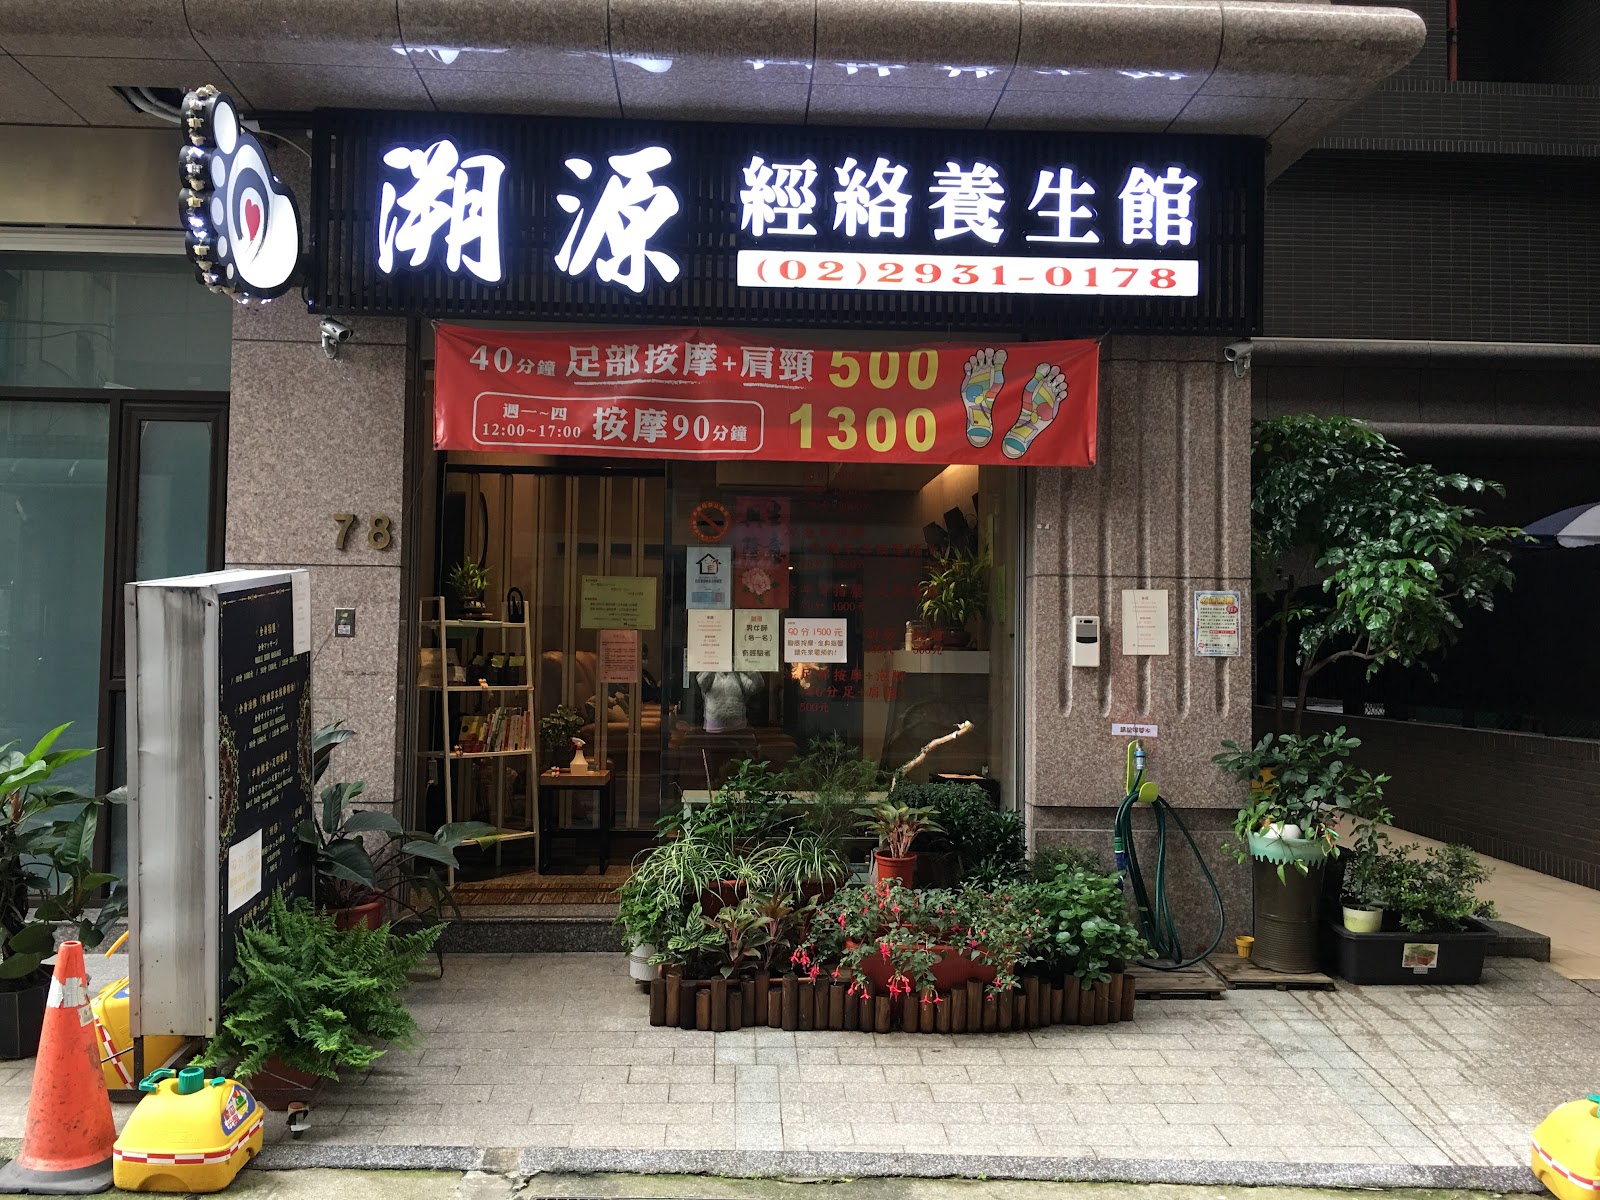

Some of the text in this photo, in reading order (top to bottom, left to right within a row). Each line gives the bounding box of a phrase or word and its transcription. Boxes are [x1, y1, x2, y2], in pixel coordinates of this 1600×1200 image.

[377, 140, 1198, 293] 溯源 經絡養生館
[757, 257, 1177, 291] (02)2931-0178
[469, 344, 556, 377] 40分鐘
[829, 348, 938, 390] 500
[482, 423, 582, 438] 12:00~17:00
[592, 404, 937, 453] 按摩90分鐘 1300
[333, 513, 392, 552] 78
[788, 628, 798, 636] 90
[801, 628, 809, 636] 分
[813, 628, 831, 636] 1500
